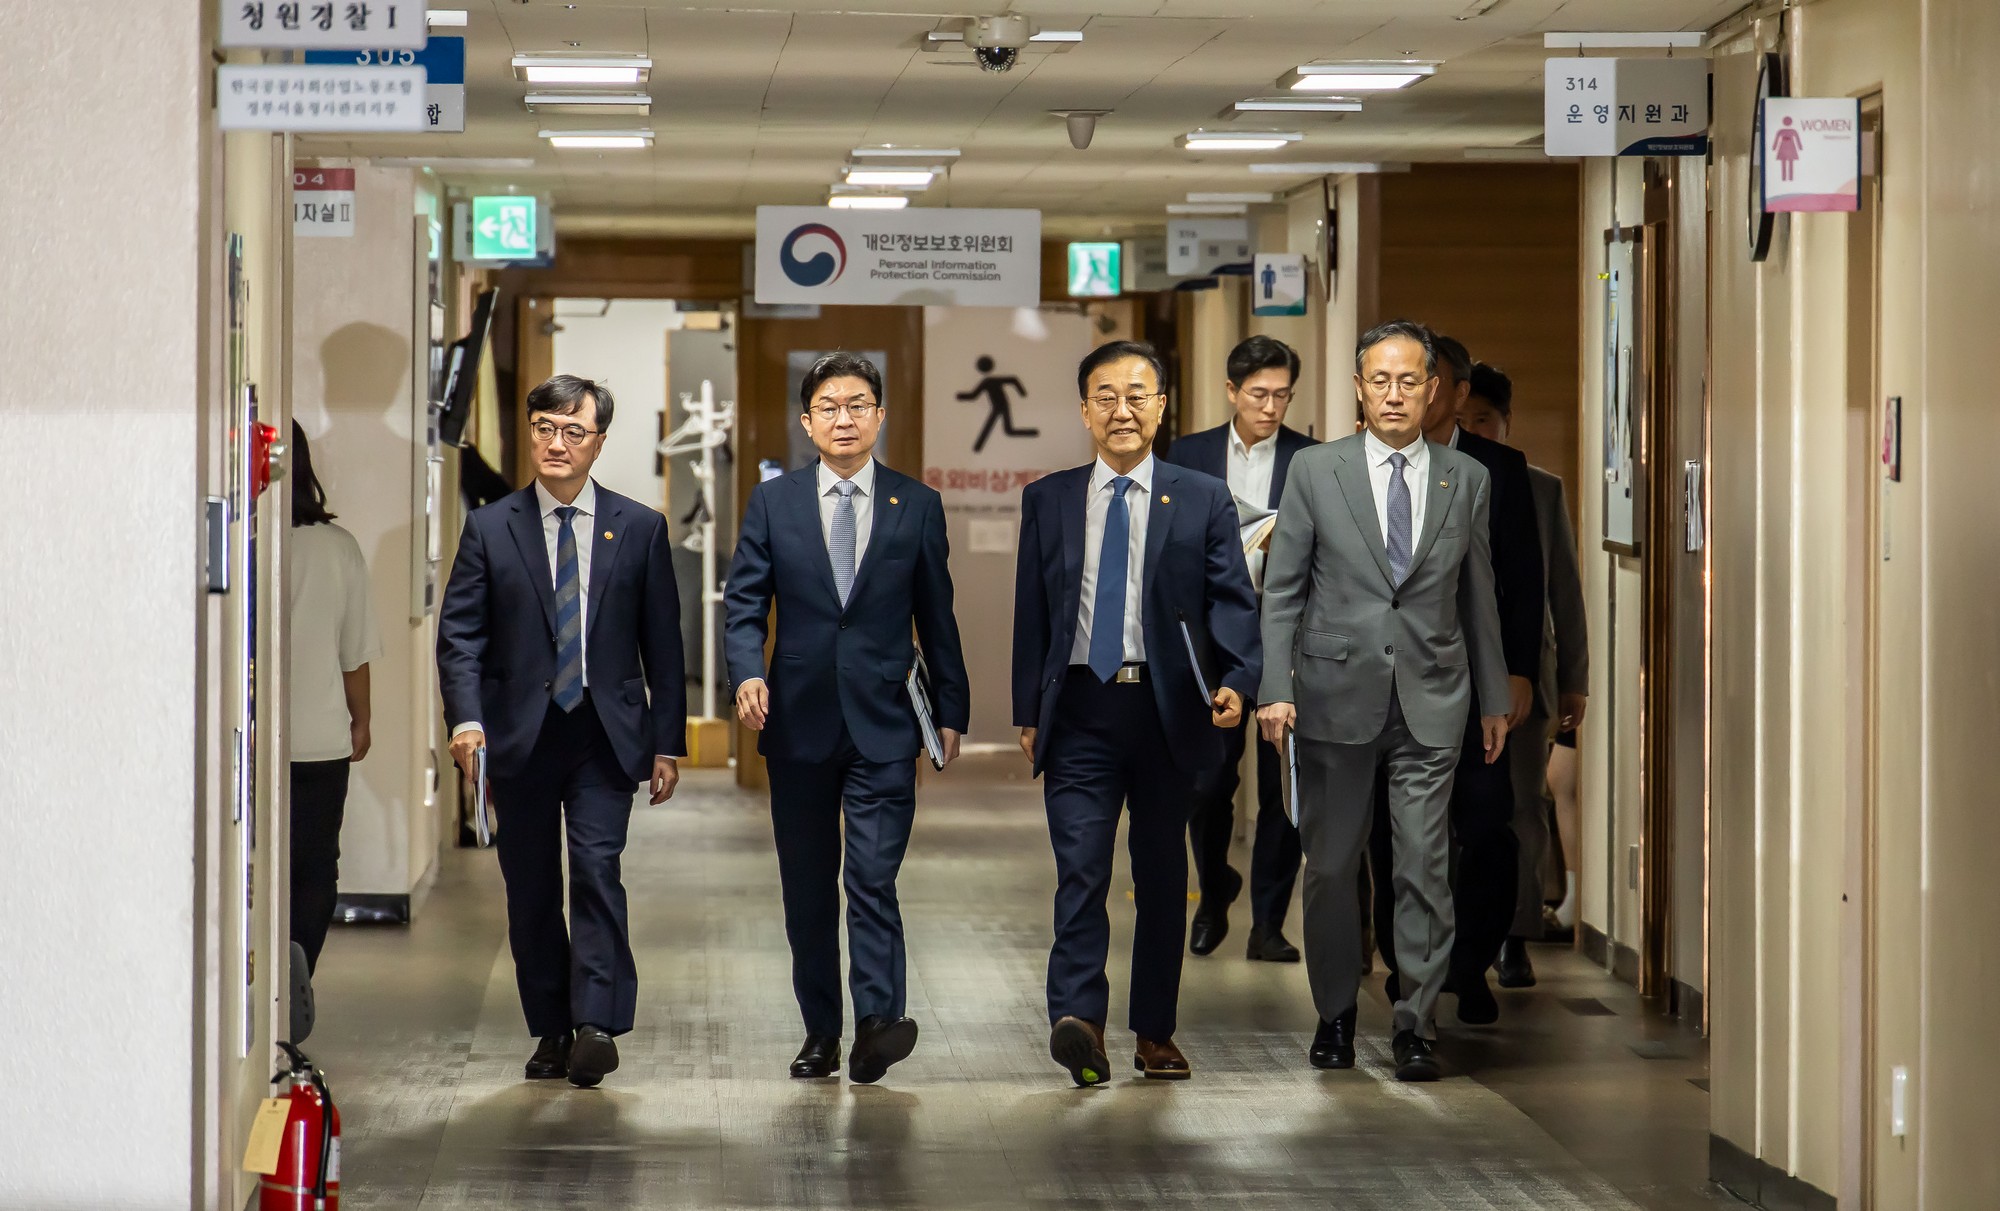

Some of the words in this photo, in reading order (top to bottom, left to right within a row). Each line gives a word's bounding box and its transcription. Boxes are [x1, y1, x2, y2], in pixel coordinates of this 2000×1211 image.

[240, 2, 372, 31] 청원경찰
[356, 49, 415, 66] 305
[1565, 77, 1598, 91] 314
[1566, 103, 1689, 124] 운영지원과
[1800, 119, 1852, 131] WOMEN
[862, 234, 1013, 253] 개인정보보호위원회
[879, 259, 928, 269] Personal
[931, 260, 997, 270] Information
[870, 269, 929, 280] Protection
[932, 270, 1001, 281] Commission
